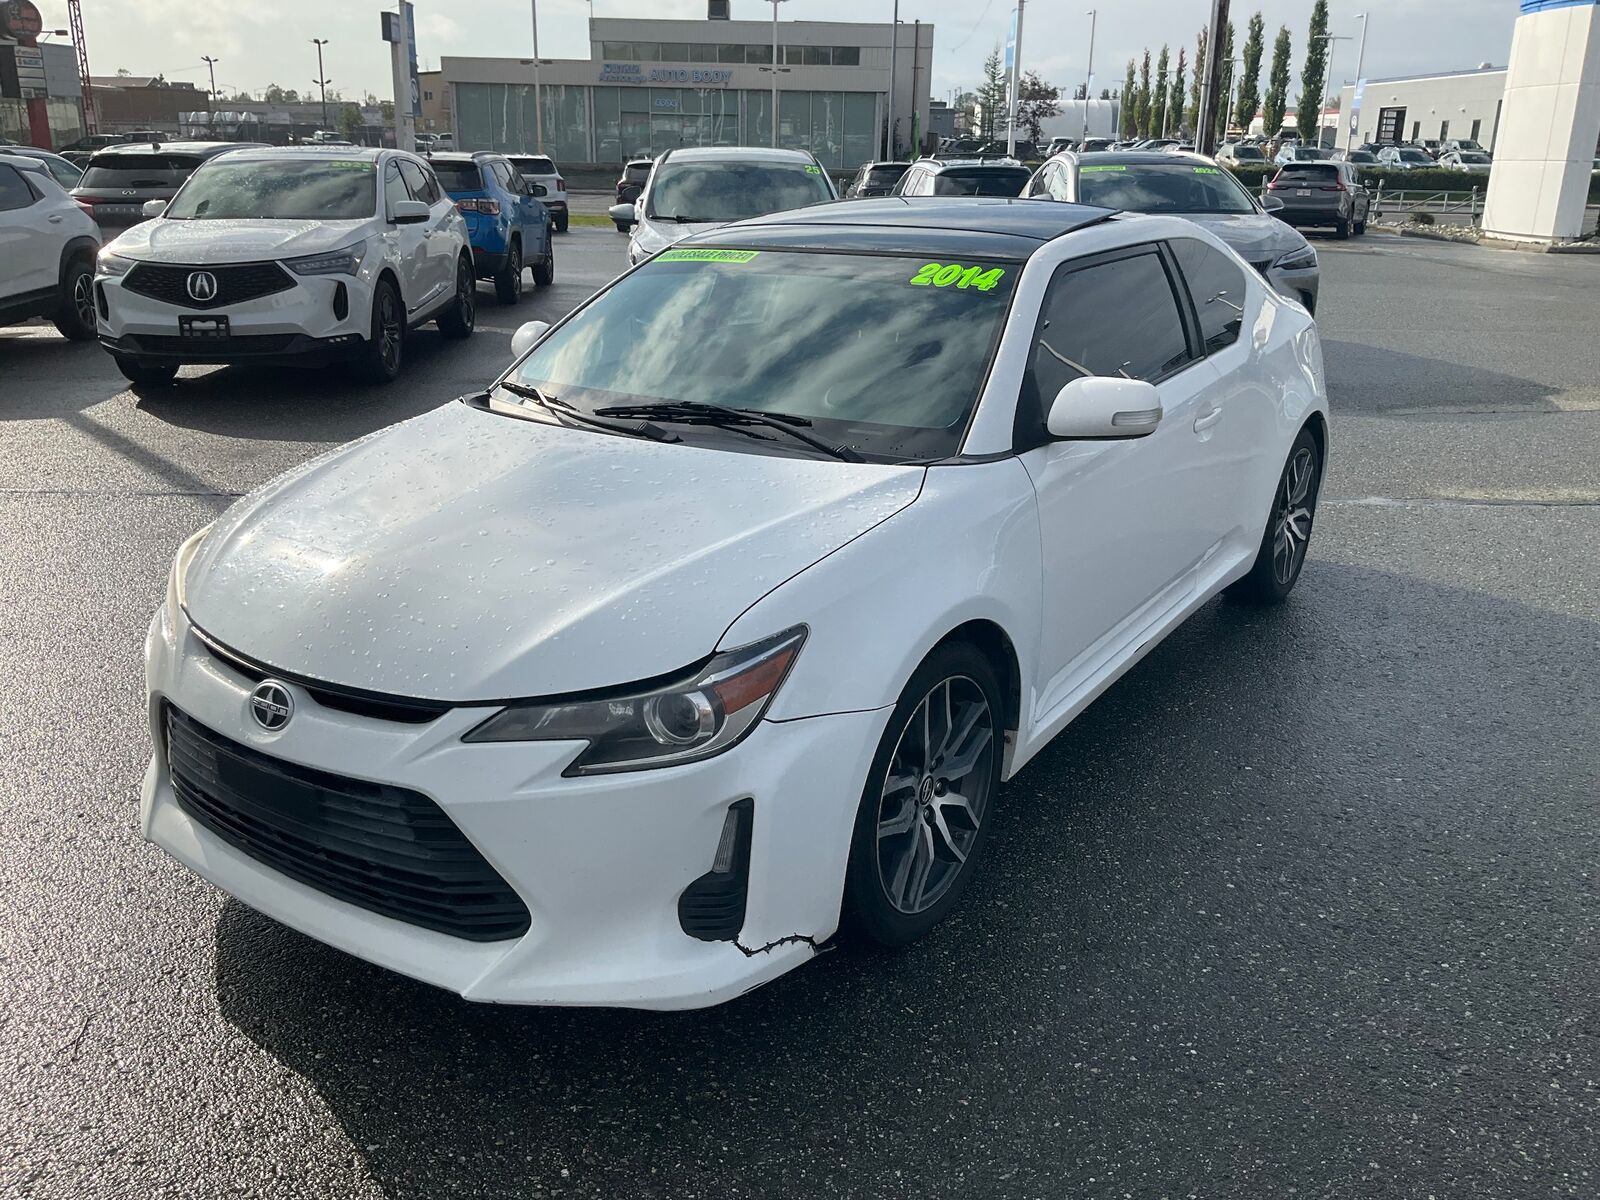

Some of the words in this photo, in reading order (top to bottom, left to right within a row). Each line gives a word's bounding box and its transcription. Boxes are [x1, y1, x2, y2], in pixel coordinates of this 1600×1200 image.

[648, 68, 689, 82] AUTO
[691, 70, 732, 84] BODY
[804, 165, 821, 176] 25
[909, 262, 1006, 291] 2014
